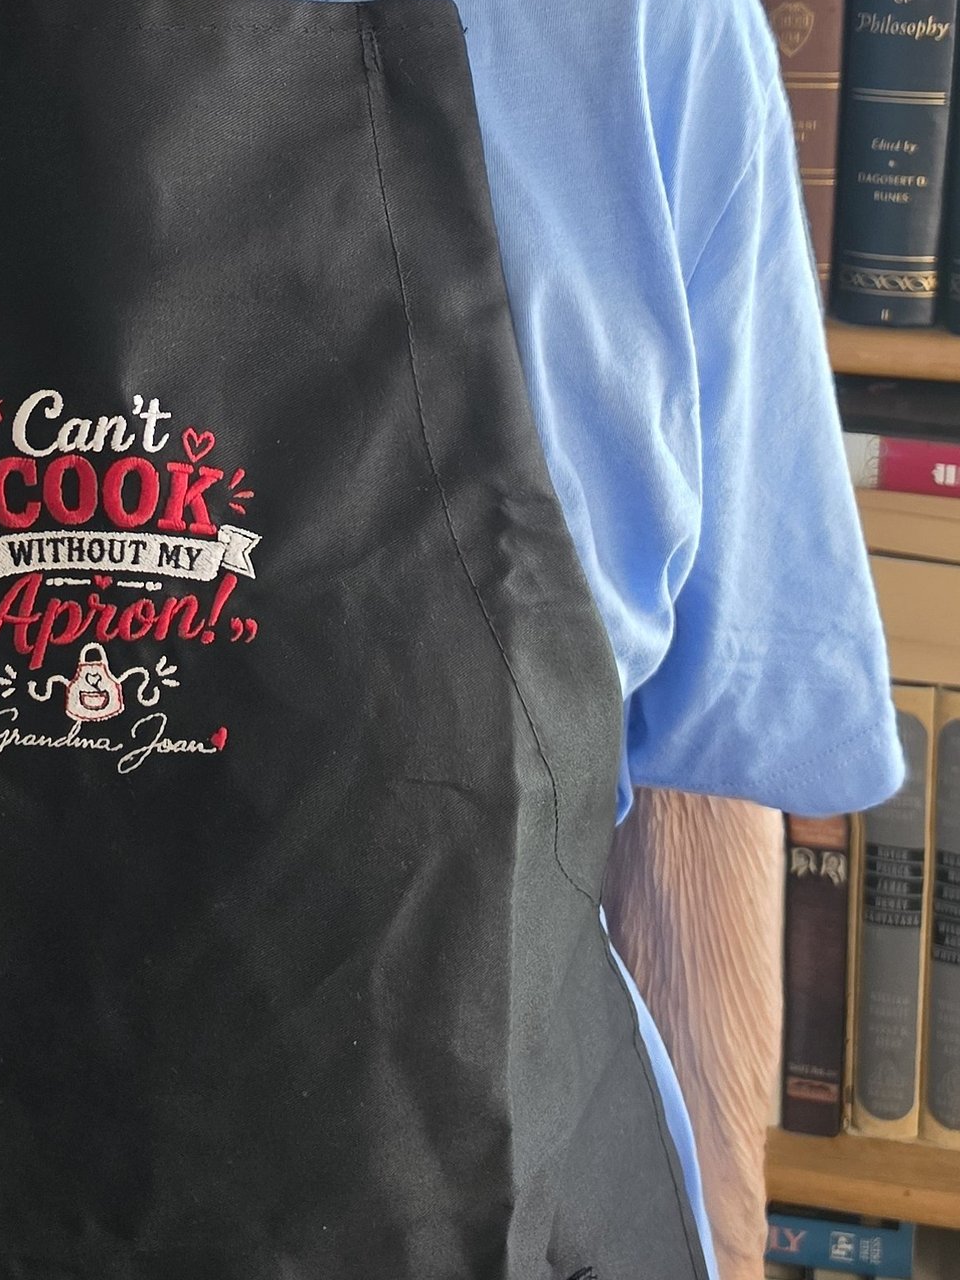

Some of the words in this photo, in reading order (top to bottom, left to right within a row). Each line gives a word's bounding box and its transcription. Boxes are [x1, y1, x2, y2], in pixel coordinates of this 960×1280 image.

[856, 11, 952, 42] Philosophy
[871, 136, 901, 153] Edited
[904, 139, 919, 154] by
[7, 537, 147, 568] WITHOUT
[157, 542, 205, 572] MY
[117, 712, 217, 775] Joan
